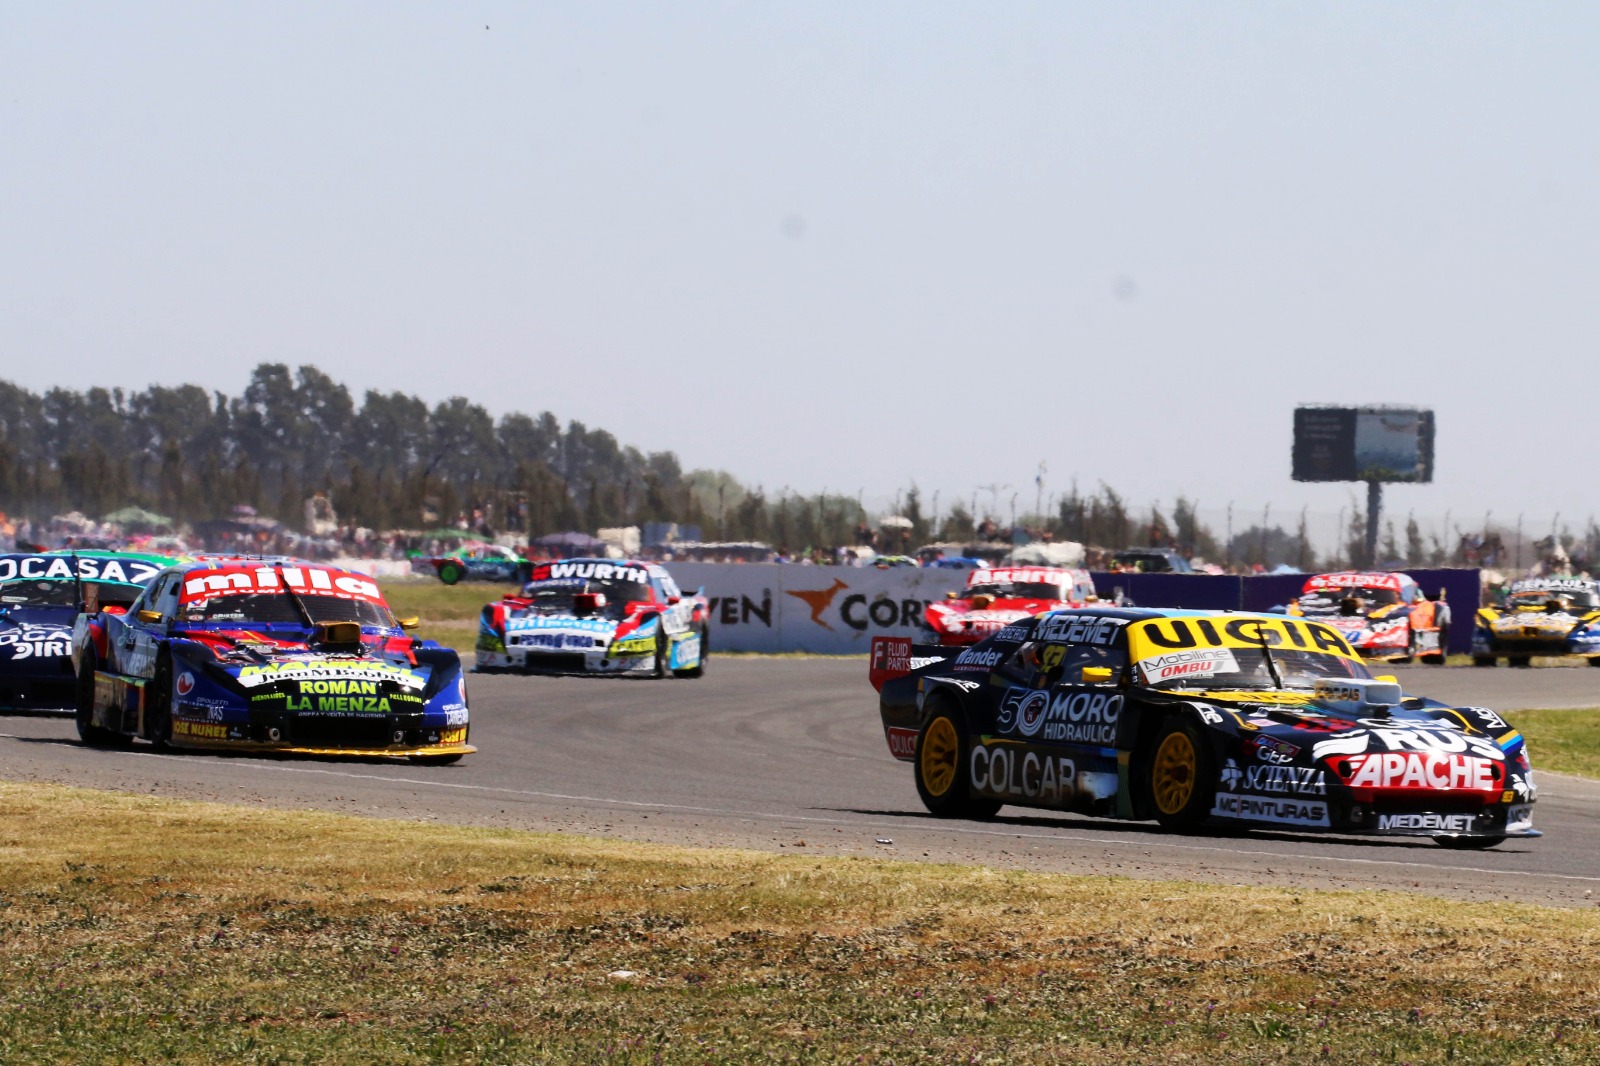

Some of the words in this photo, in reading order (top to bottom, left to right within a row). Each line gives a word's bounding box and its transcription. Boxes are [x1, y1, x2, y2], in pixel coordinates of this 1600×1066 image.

[0, 558, 129, 583] OCASA
[185, 567, 380, 598] milla
[1328, 575, 1396, 588] SCIENZA
[840, 593, 935, 630] COR
[0, 630, 73, 645] OCA
[1031, 614, 1132, 646] MEDEMET
[888, 642, 908, 657] FLUID
[955, 647, 1003, 667] Wander
[1143, 649, 1229, 670] Mobiline
[888, 657, 911, 672] PARTS
[1161, 661, 1212, 678] OMBU
[299, 680, 377, 695] ROMAN
[286, 696, 313, 710] LA
[319, 697, 392, 712] MENZA
[1044, 722, 1117, 743] HIDRAULICA
[1369, 729, 1506, 761] RUS
[970, 745, 1076, 798] COLCAR
[1242, 764, 1328, 795] SCIENZA
[1350, 753, 1494, 791] APACHE
[1378, 815, 1477, 832] MEDEMET
